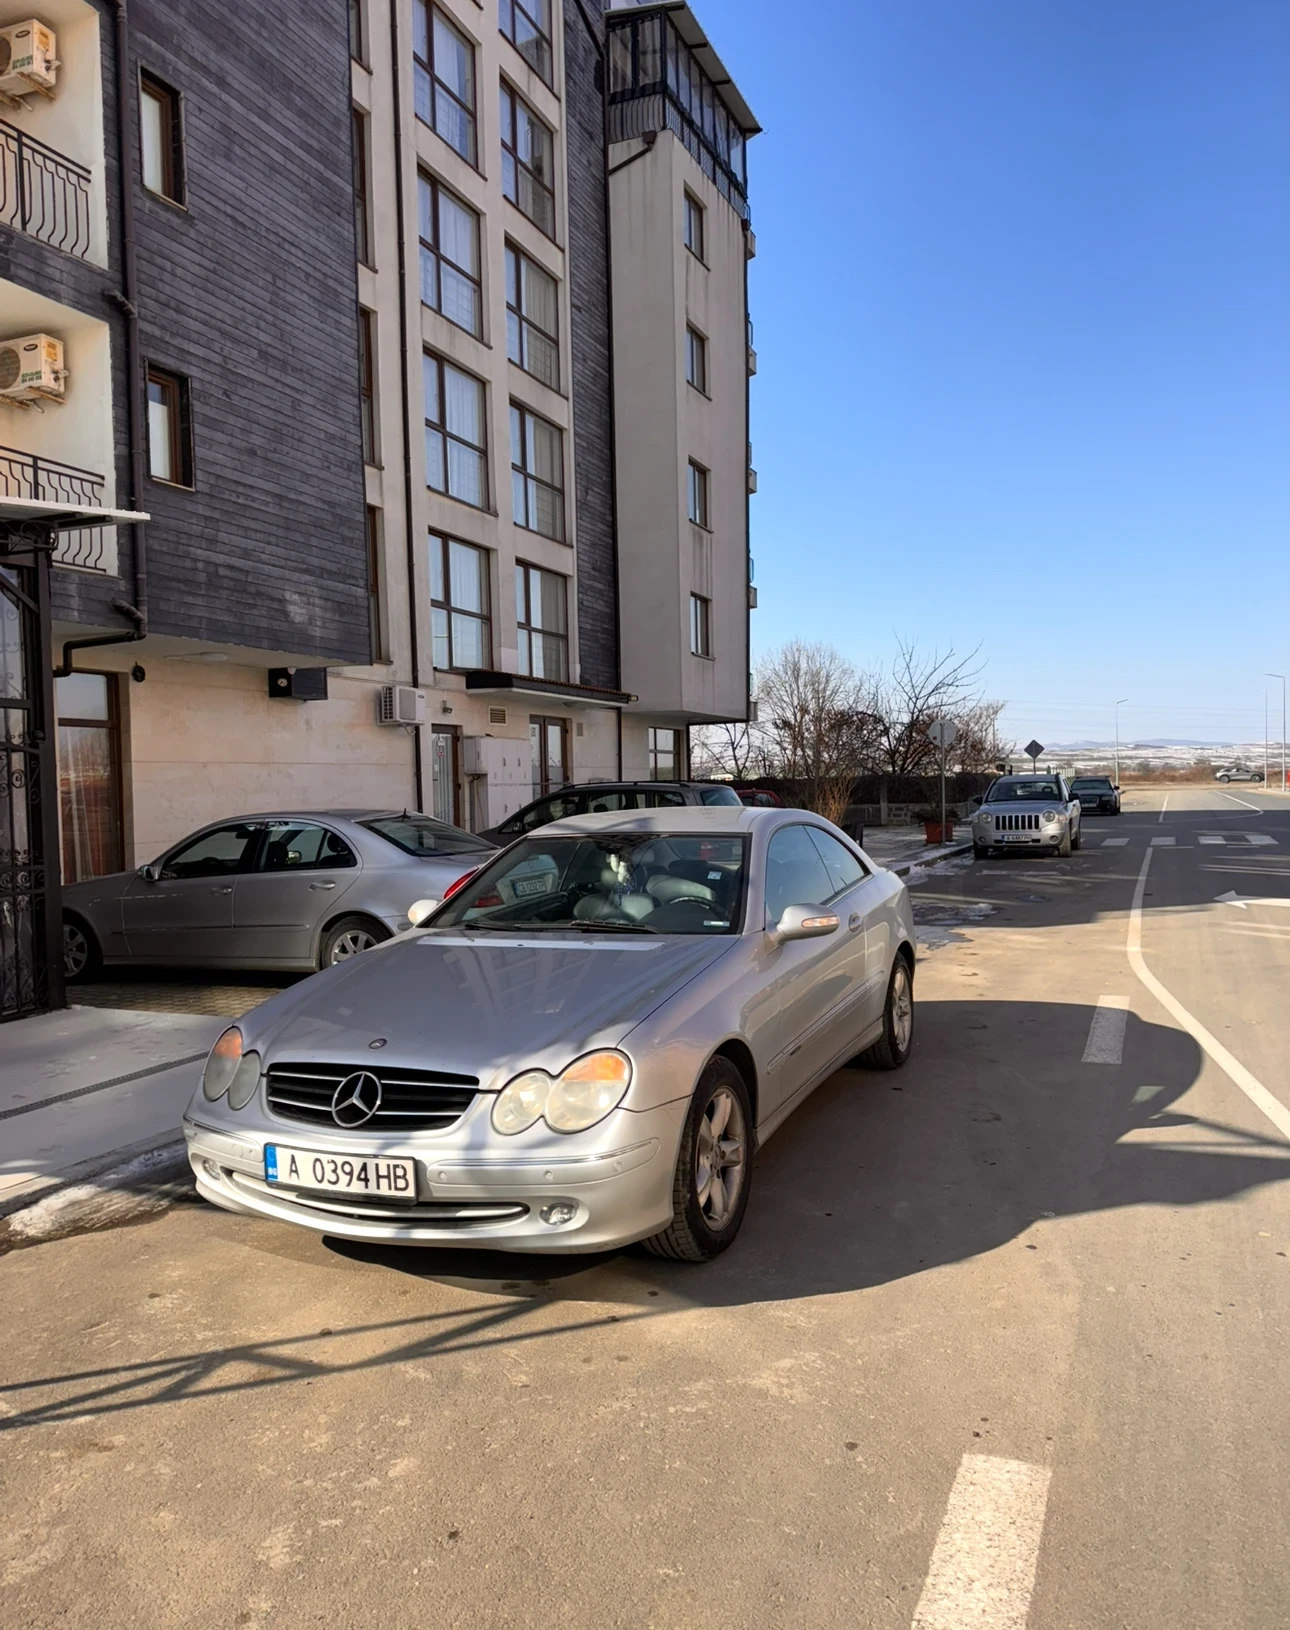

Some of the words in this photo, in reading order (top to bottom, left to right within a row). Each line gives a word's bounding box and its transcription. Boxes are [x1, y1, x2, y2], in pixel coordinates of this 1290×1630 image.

[268, 1167, 277, 1176] BG
[289, 1154, 299, 1179] A
[312, 1157, 370, 1189] 0394
[375, 1163, 409, 1191] HB
